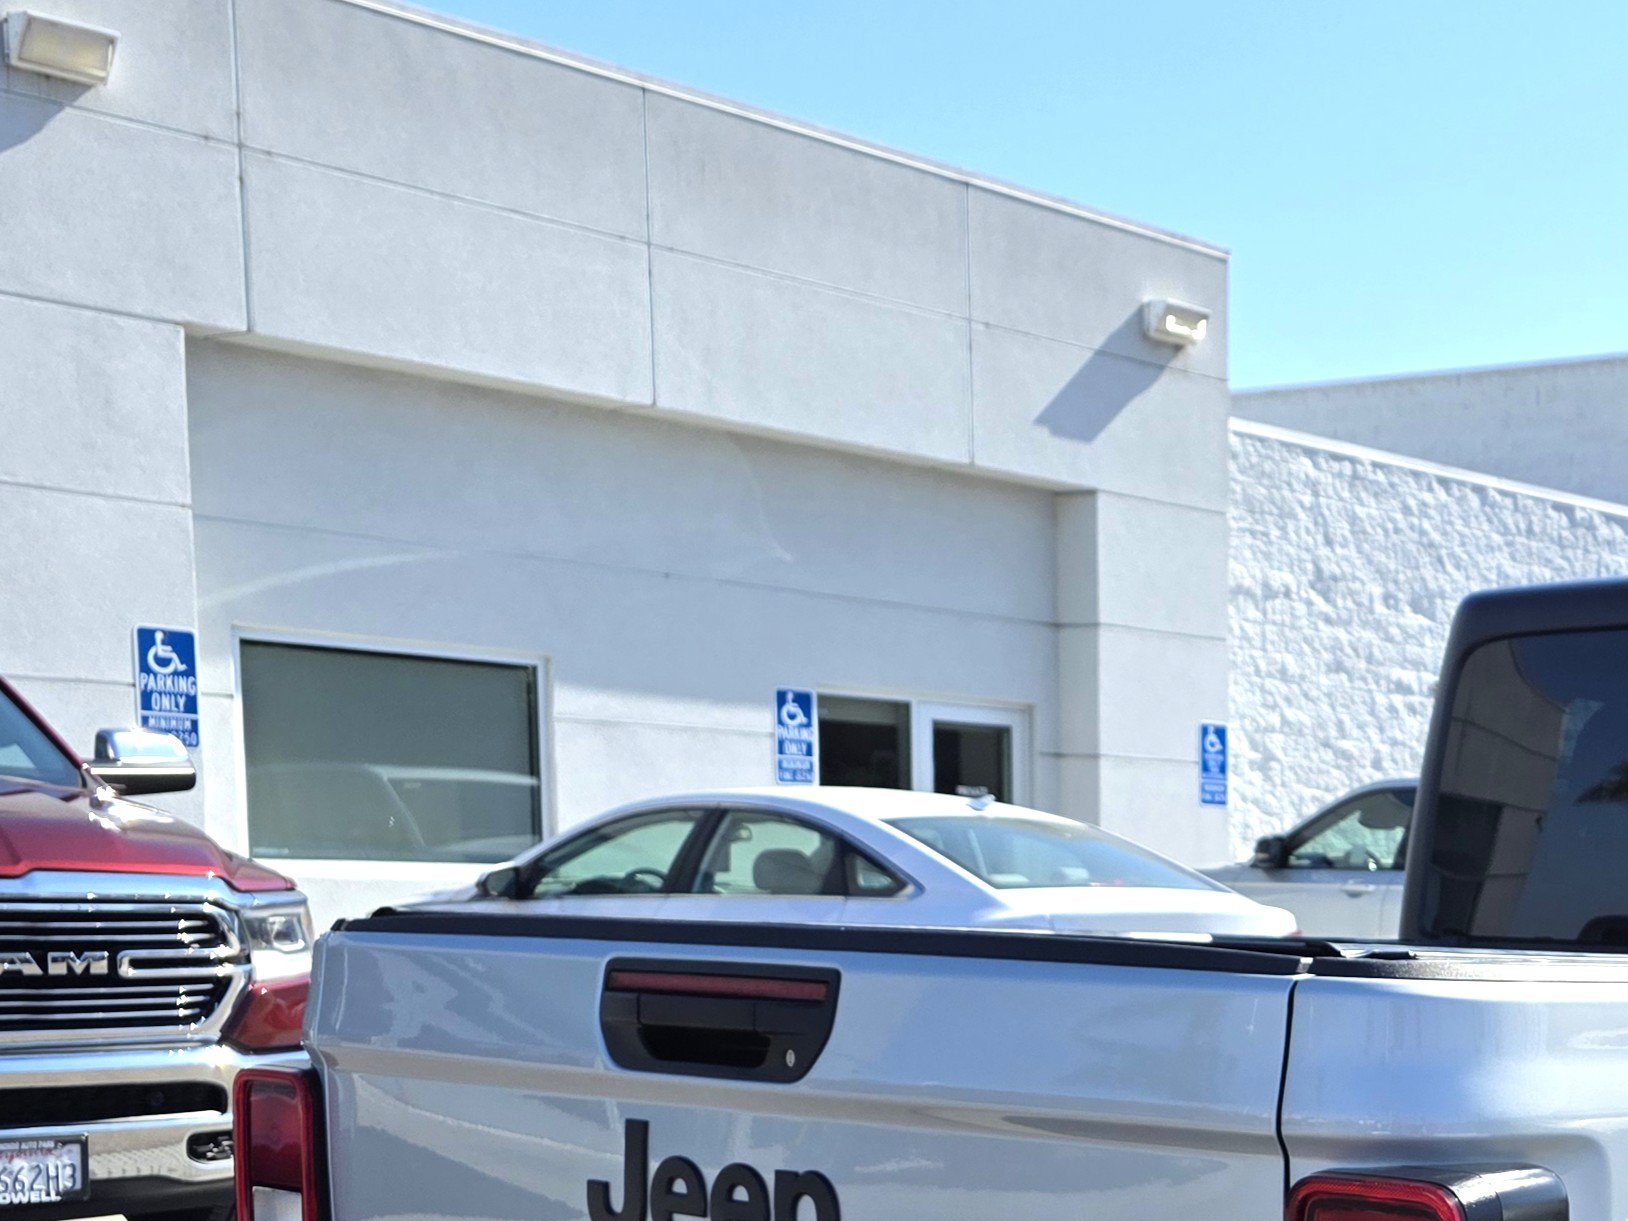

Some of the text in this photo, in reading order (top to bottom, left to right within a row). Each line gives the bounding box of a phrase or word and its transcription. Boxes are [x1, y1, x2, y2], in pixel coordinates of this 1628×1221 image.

[140, 672, 197, 696] PARKING
[151, 692, 186, 712] ONLY
[148, 715, 192, 731] MINIMUM
[0, 951, 110, 976] AM
[0, 1190, 63, 1206] OWELL
